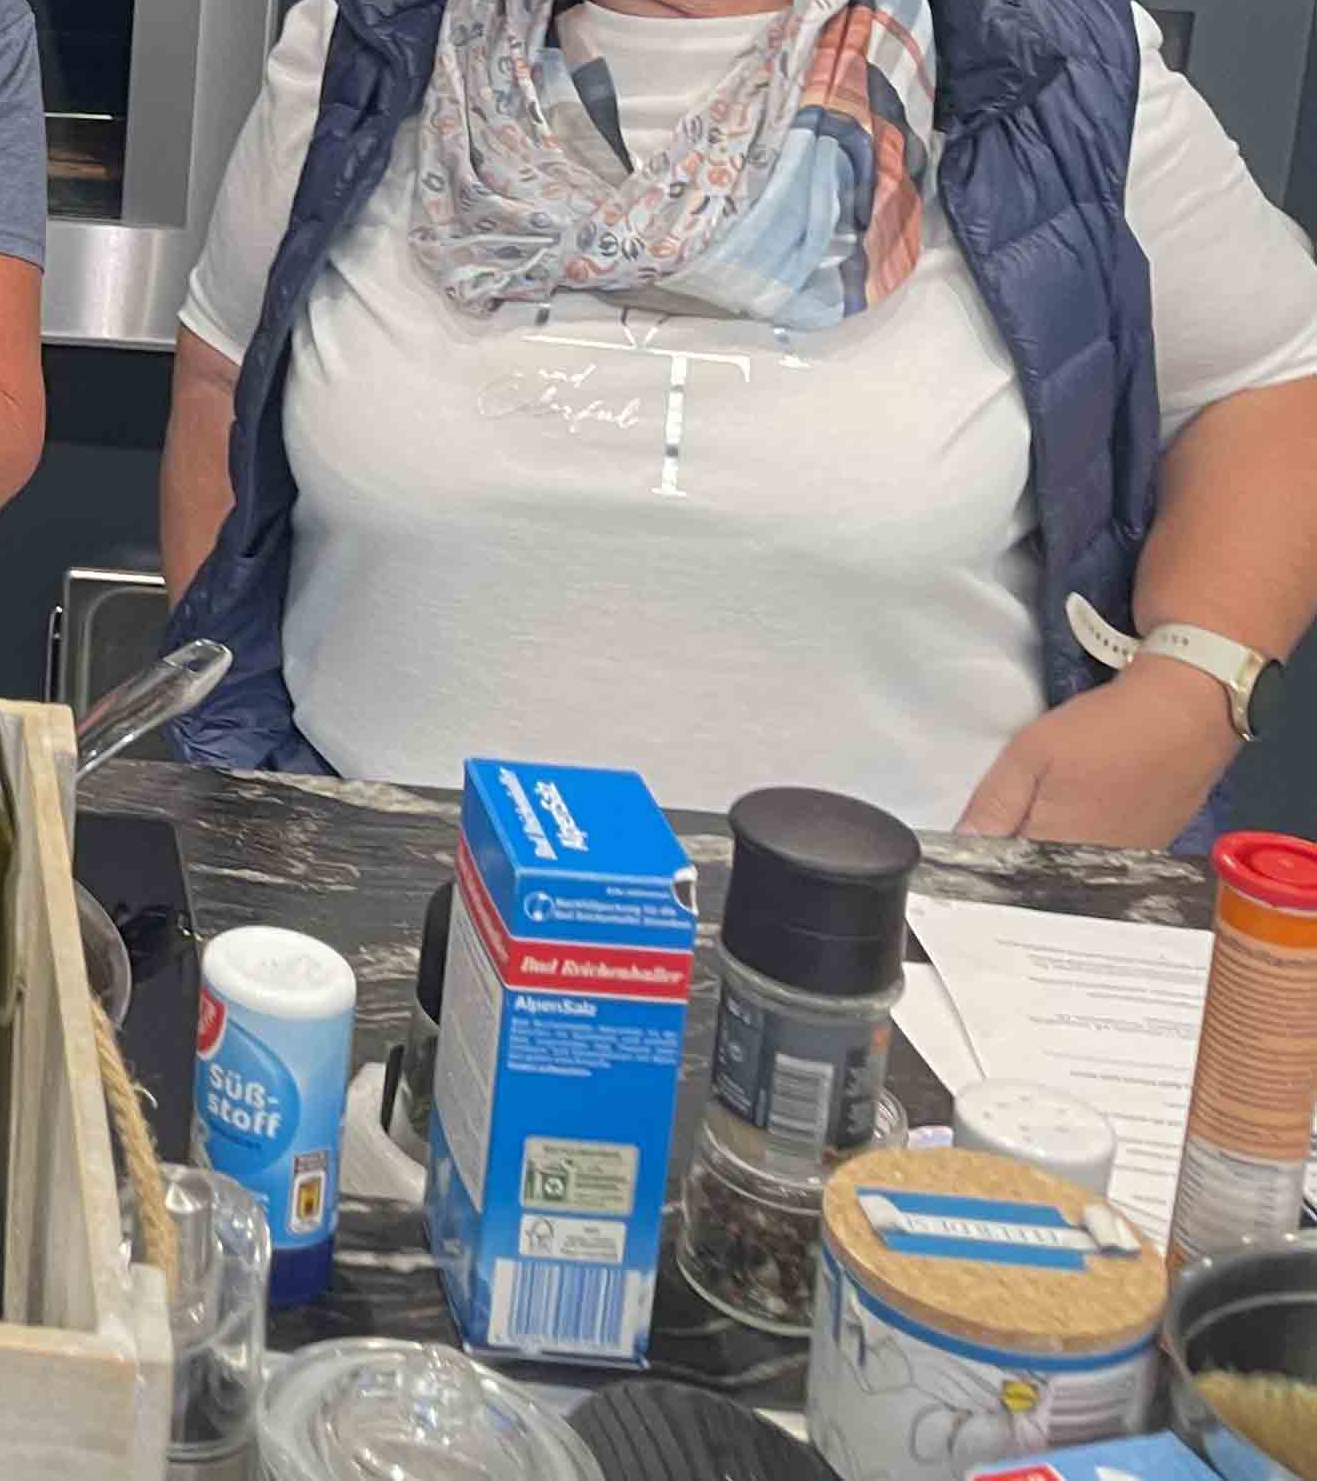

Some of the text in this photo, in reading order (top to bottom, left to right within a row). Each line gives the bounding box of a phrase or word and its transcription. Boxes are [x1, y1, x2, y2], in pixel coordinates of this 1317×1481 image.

[520, 955, 558, 976] Bad
[208, 1061, 280, 1106] Süß-
[206, 1090, 282, 1139] stoff
